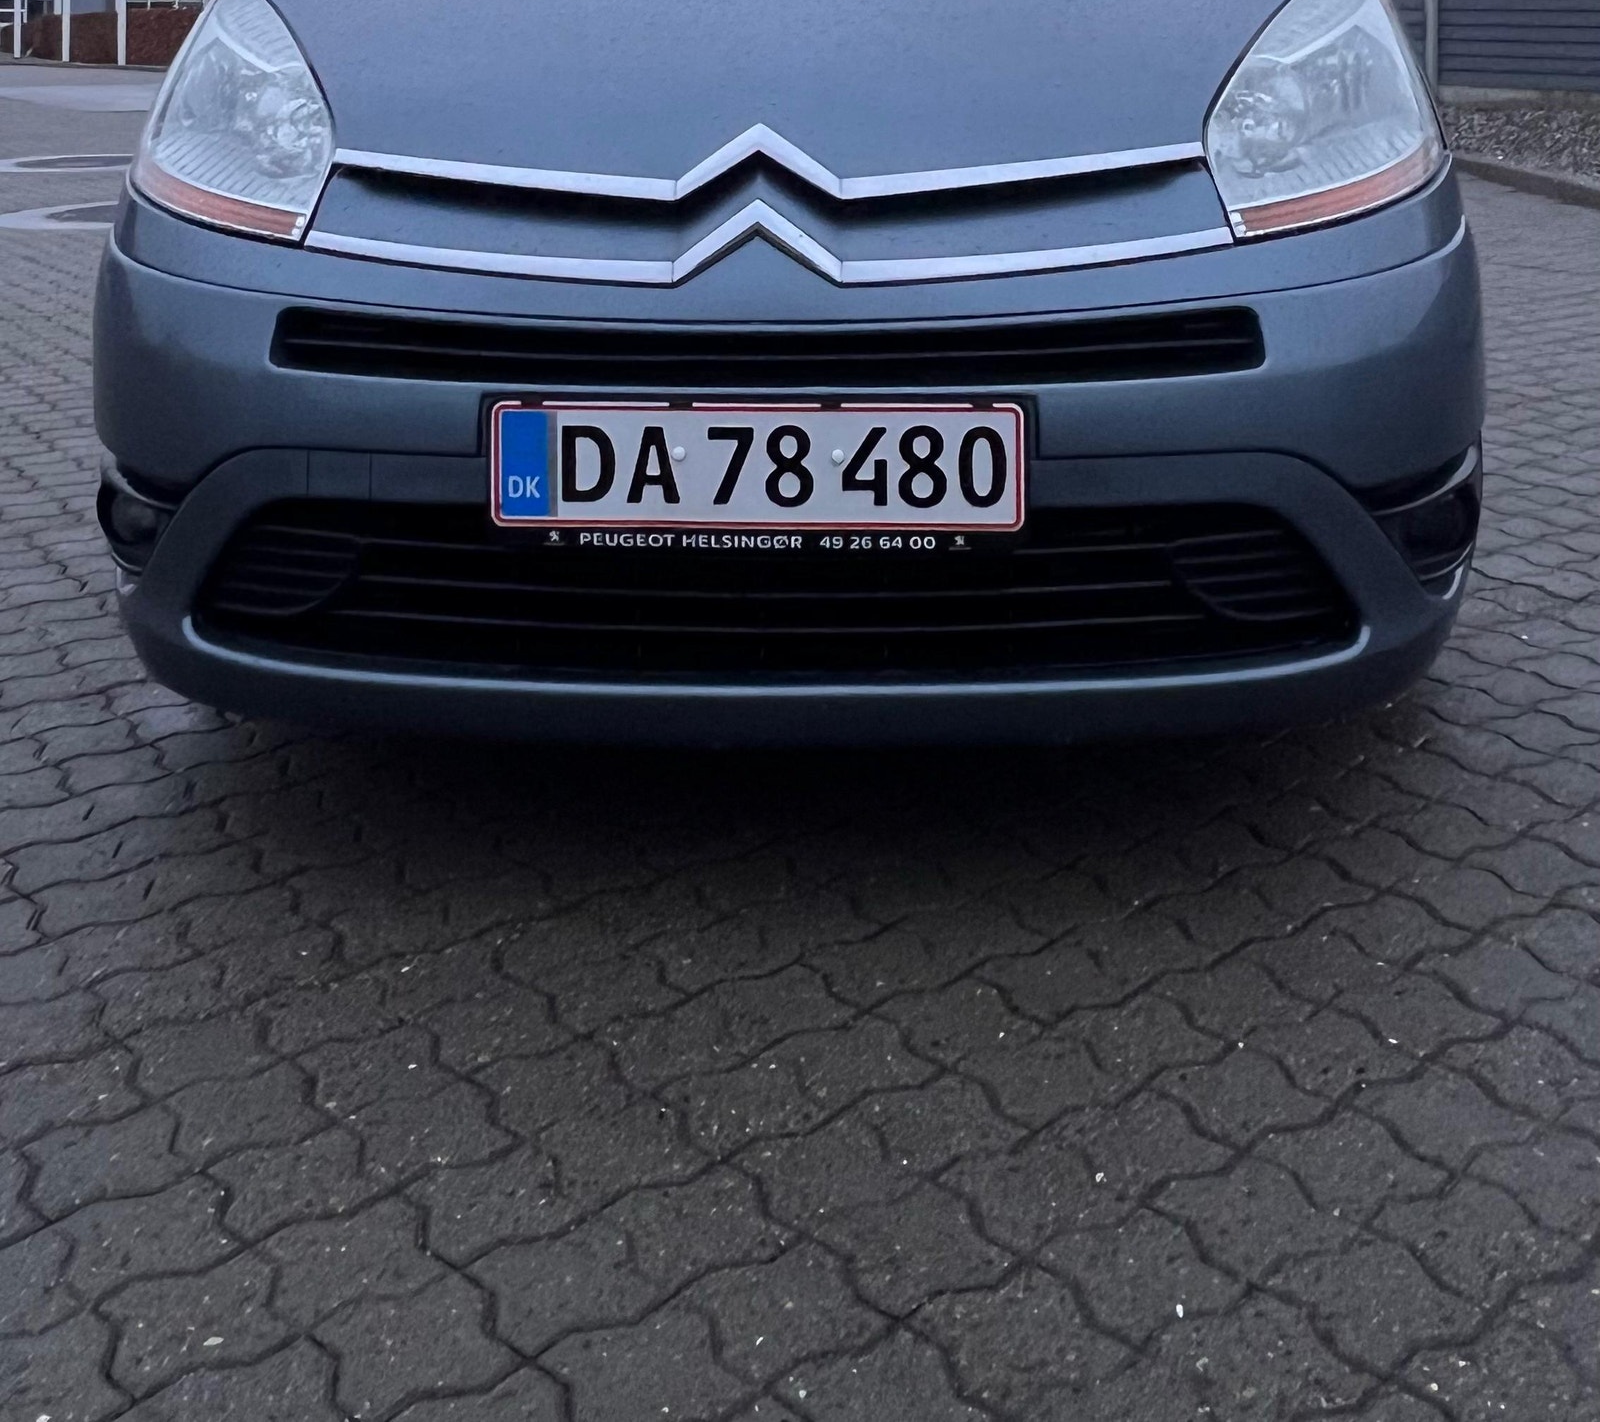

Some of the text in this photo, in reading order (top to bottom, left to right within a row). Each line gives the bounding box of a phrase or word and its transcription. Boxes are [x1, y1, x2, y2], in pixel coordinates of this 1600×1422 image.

[561, 425, 1007, 508] DA 78 480
[507, 475, 541, 499] DK
[580, 532, 936, 549] PEUGEOT HELSINGØR 49 26 64 00
